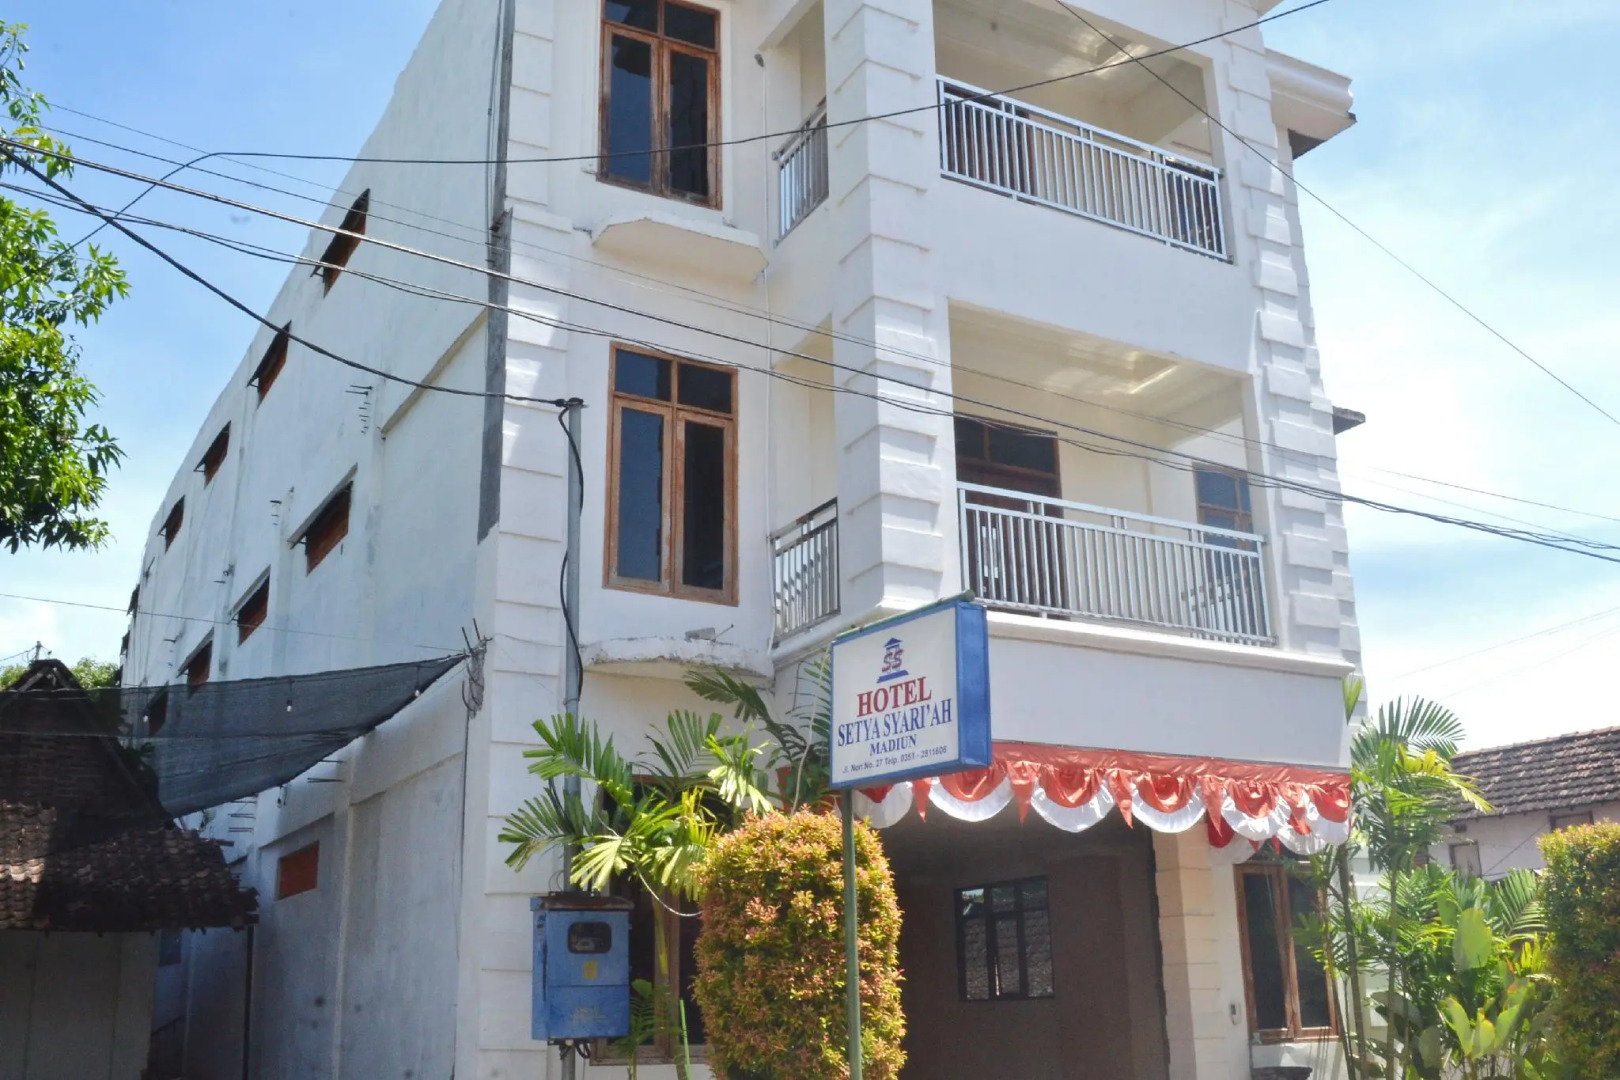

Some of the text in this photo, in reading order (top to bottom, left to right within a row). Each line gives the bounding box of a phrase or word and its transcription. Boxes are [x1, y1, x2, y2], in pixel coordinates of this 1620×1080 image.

[856, 676, 932, 717] HOTEL
[838, 698, 952, 747] SETYA SYARI'AH
[864, 761, 875, 770] No.
[876, 758, 883, 768] 27
[900, 752, 915, 762] 0351
[869, 734, 917, 757] MADIUN
